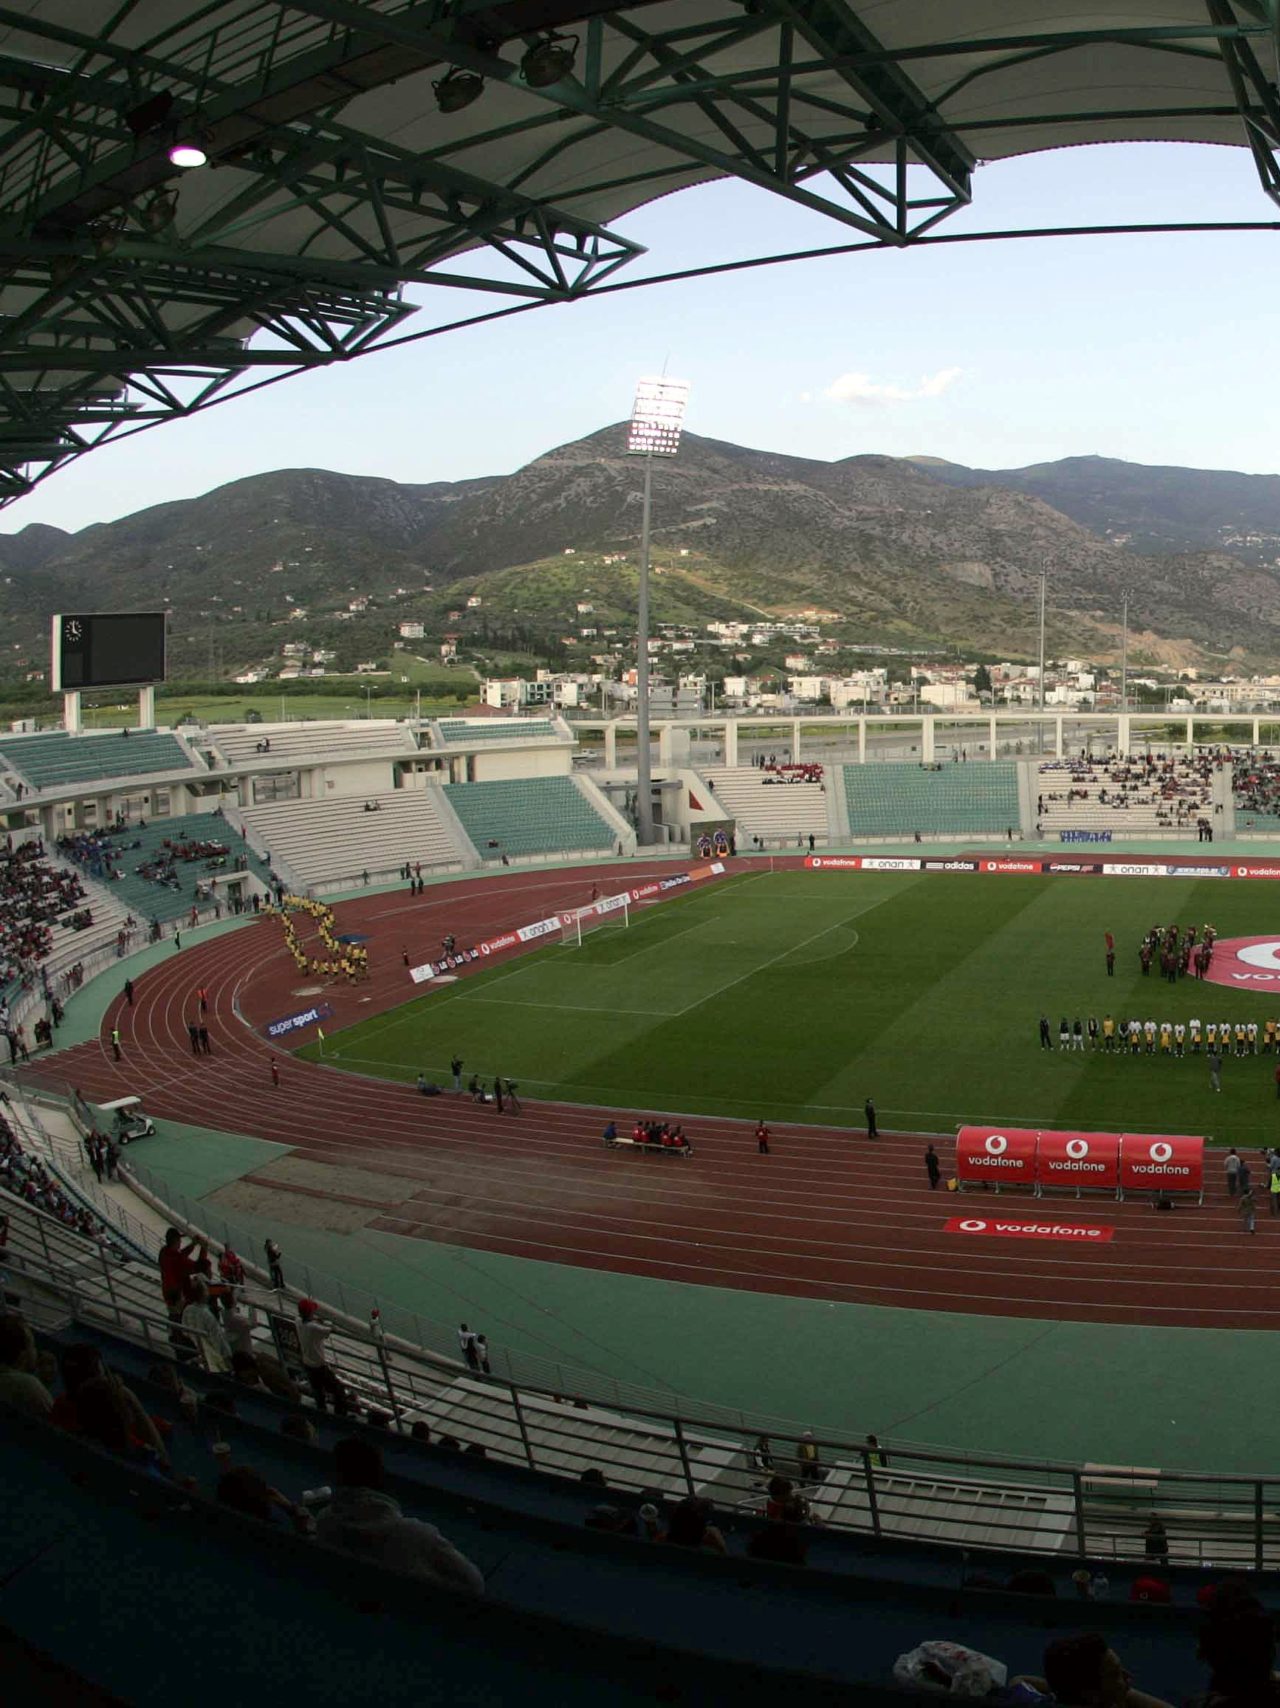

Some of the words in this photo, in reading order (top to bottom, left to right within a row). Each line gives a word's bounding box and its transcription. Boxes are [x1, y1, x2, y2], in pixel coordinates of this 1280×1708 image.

[822, 858, 856, 866] vodafone
[944, 861, 974, 870] adidas
[998, 861, 1033, 870] vodafone
[968, 1155, 1024, 1168] vodafone
[1048, 1160, 1105, 1172] vodafone
[1132, 1163, 1190, 1176] vodafone
[995, 1223, 1101, 1238] vodafone
